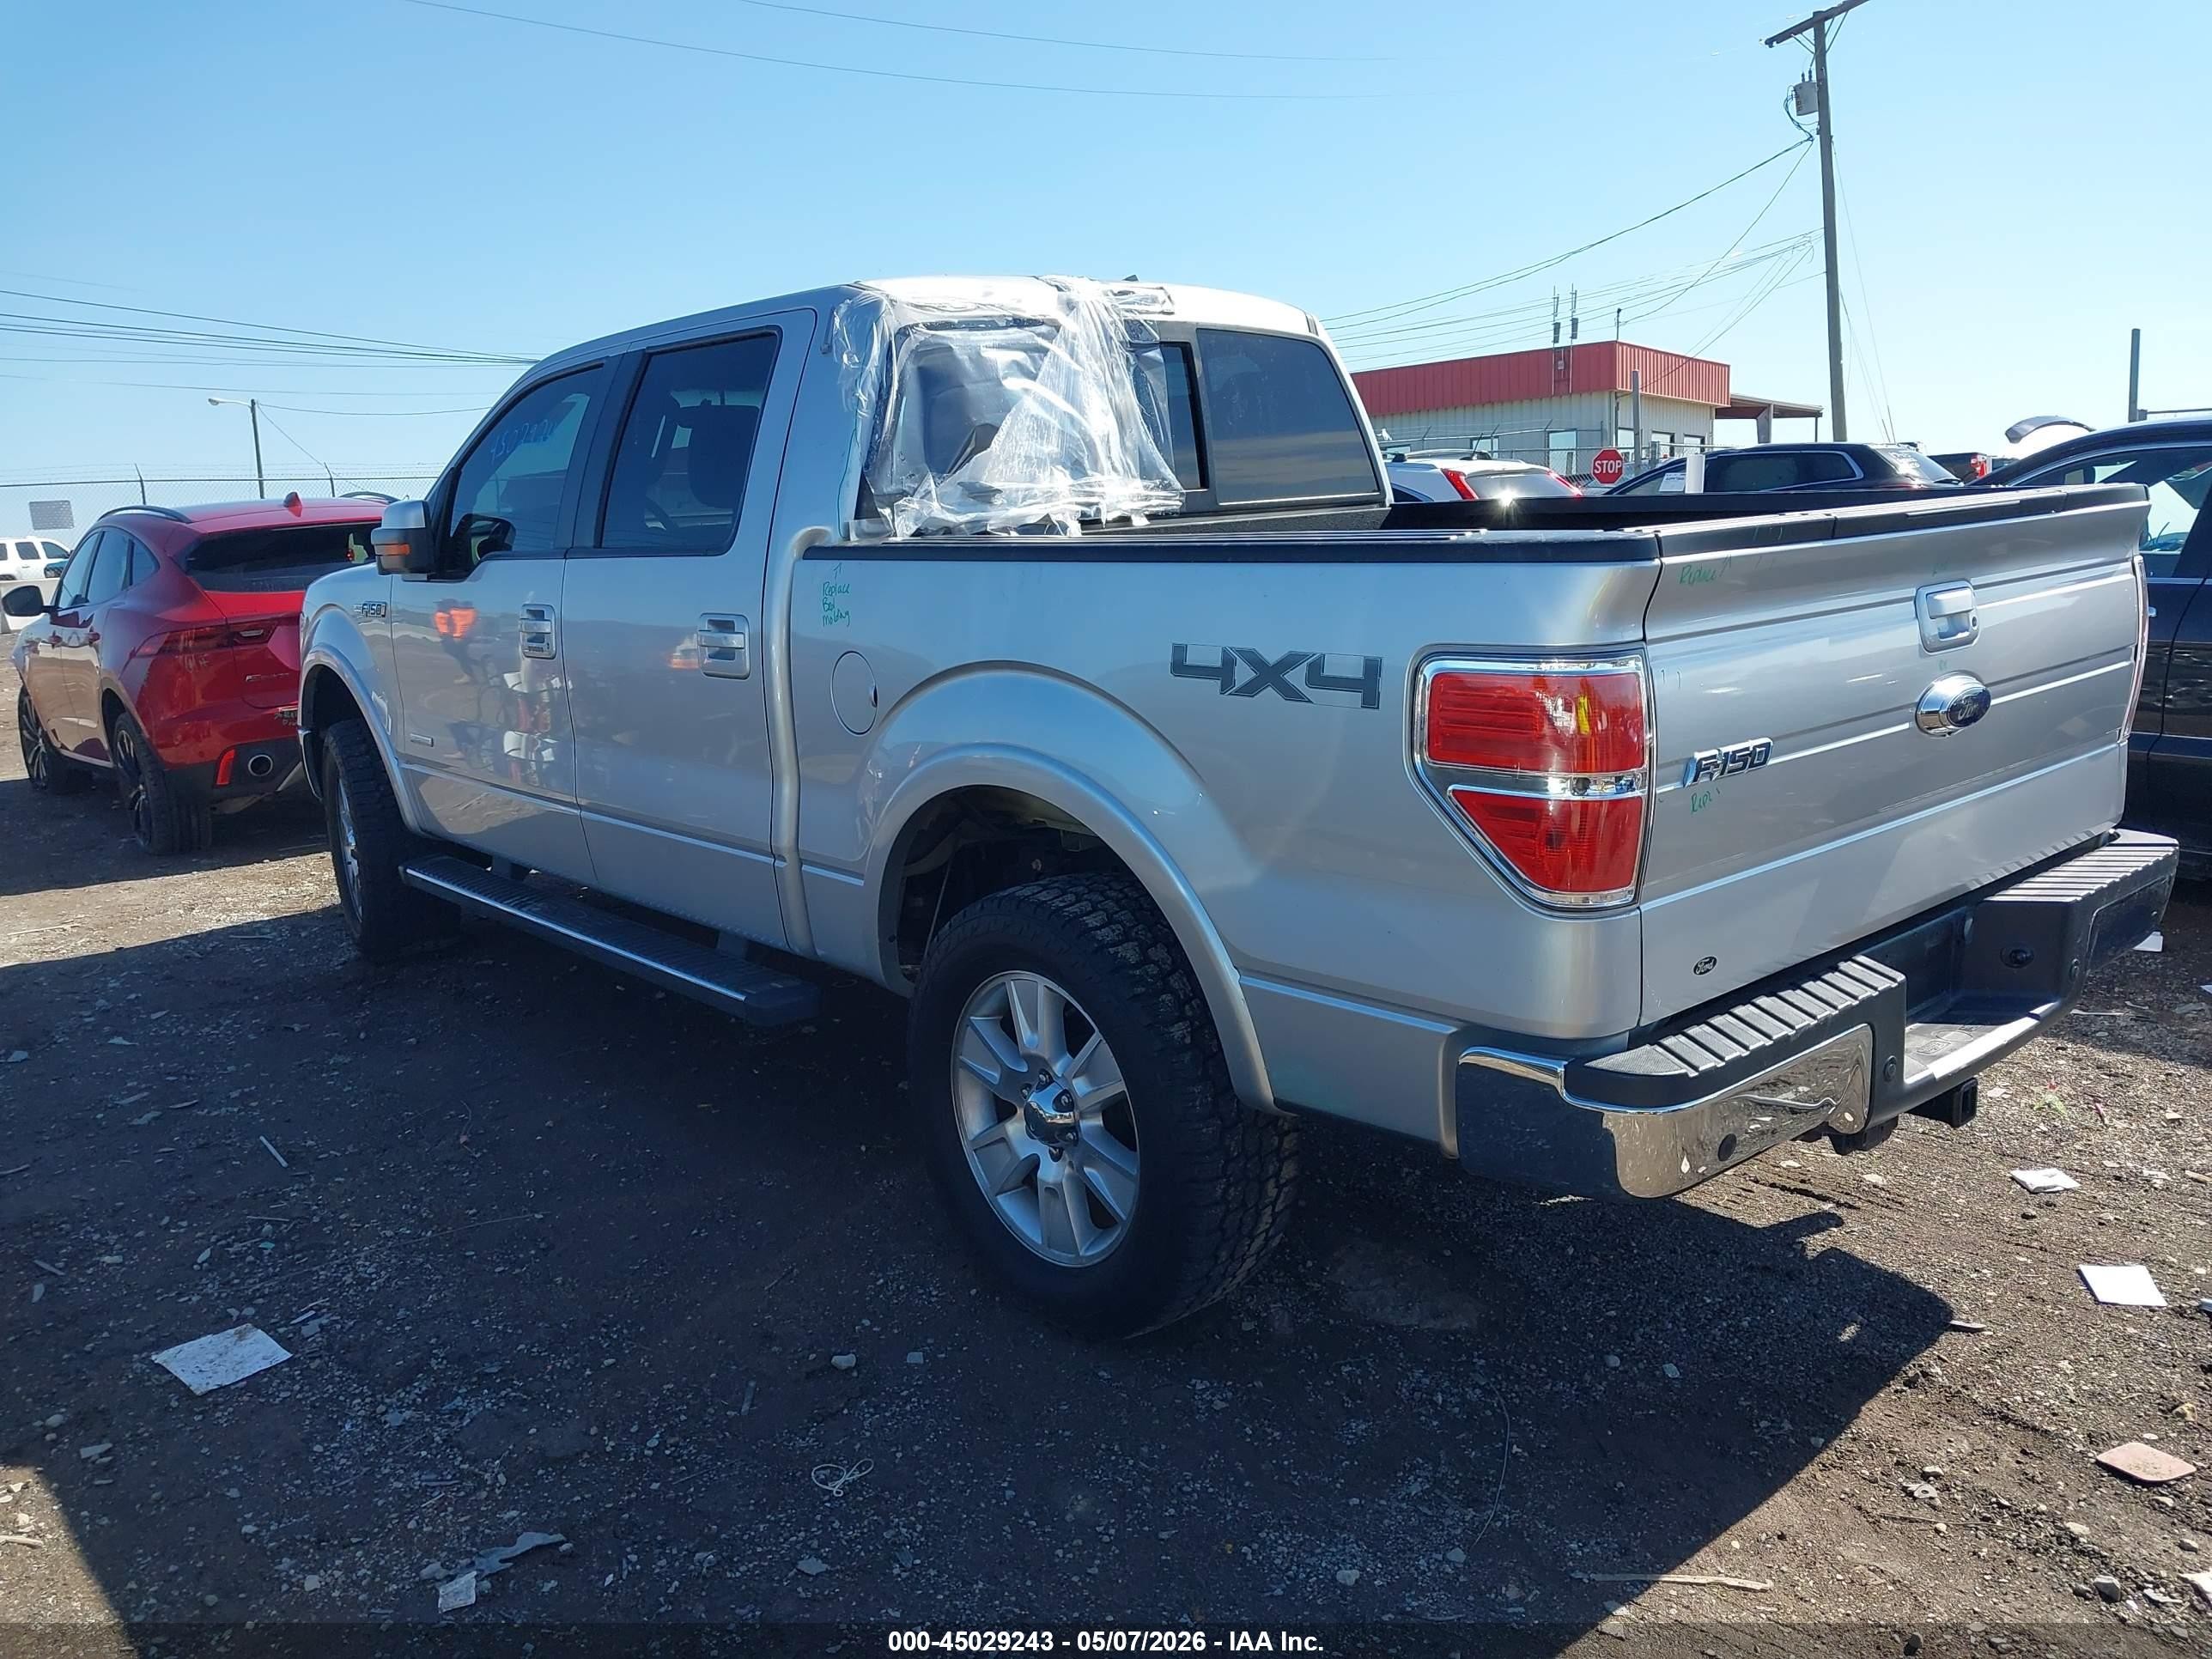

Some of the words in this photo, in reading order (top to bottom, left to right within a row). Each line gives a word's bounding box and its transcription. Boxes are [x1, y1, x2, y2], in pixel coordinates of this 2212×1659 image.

[1594, 460, 1622, 474] STOP
[1685, 738, 1773, 787] F-150
[1694, 957, 1716, 975] Ford
